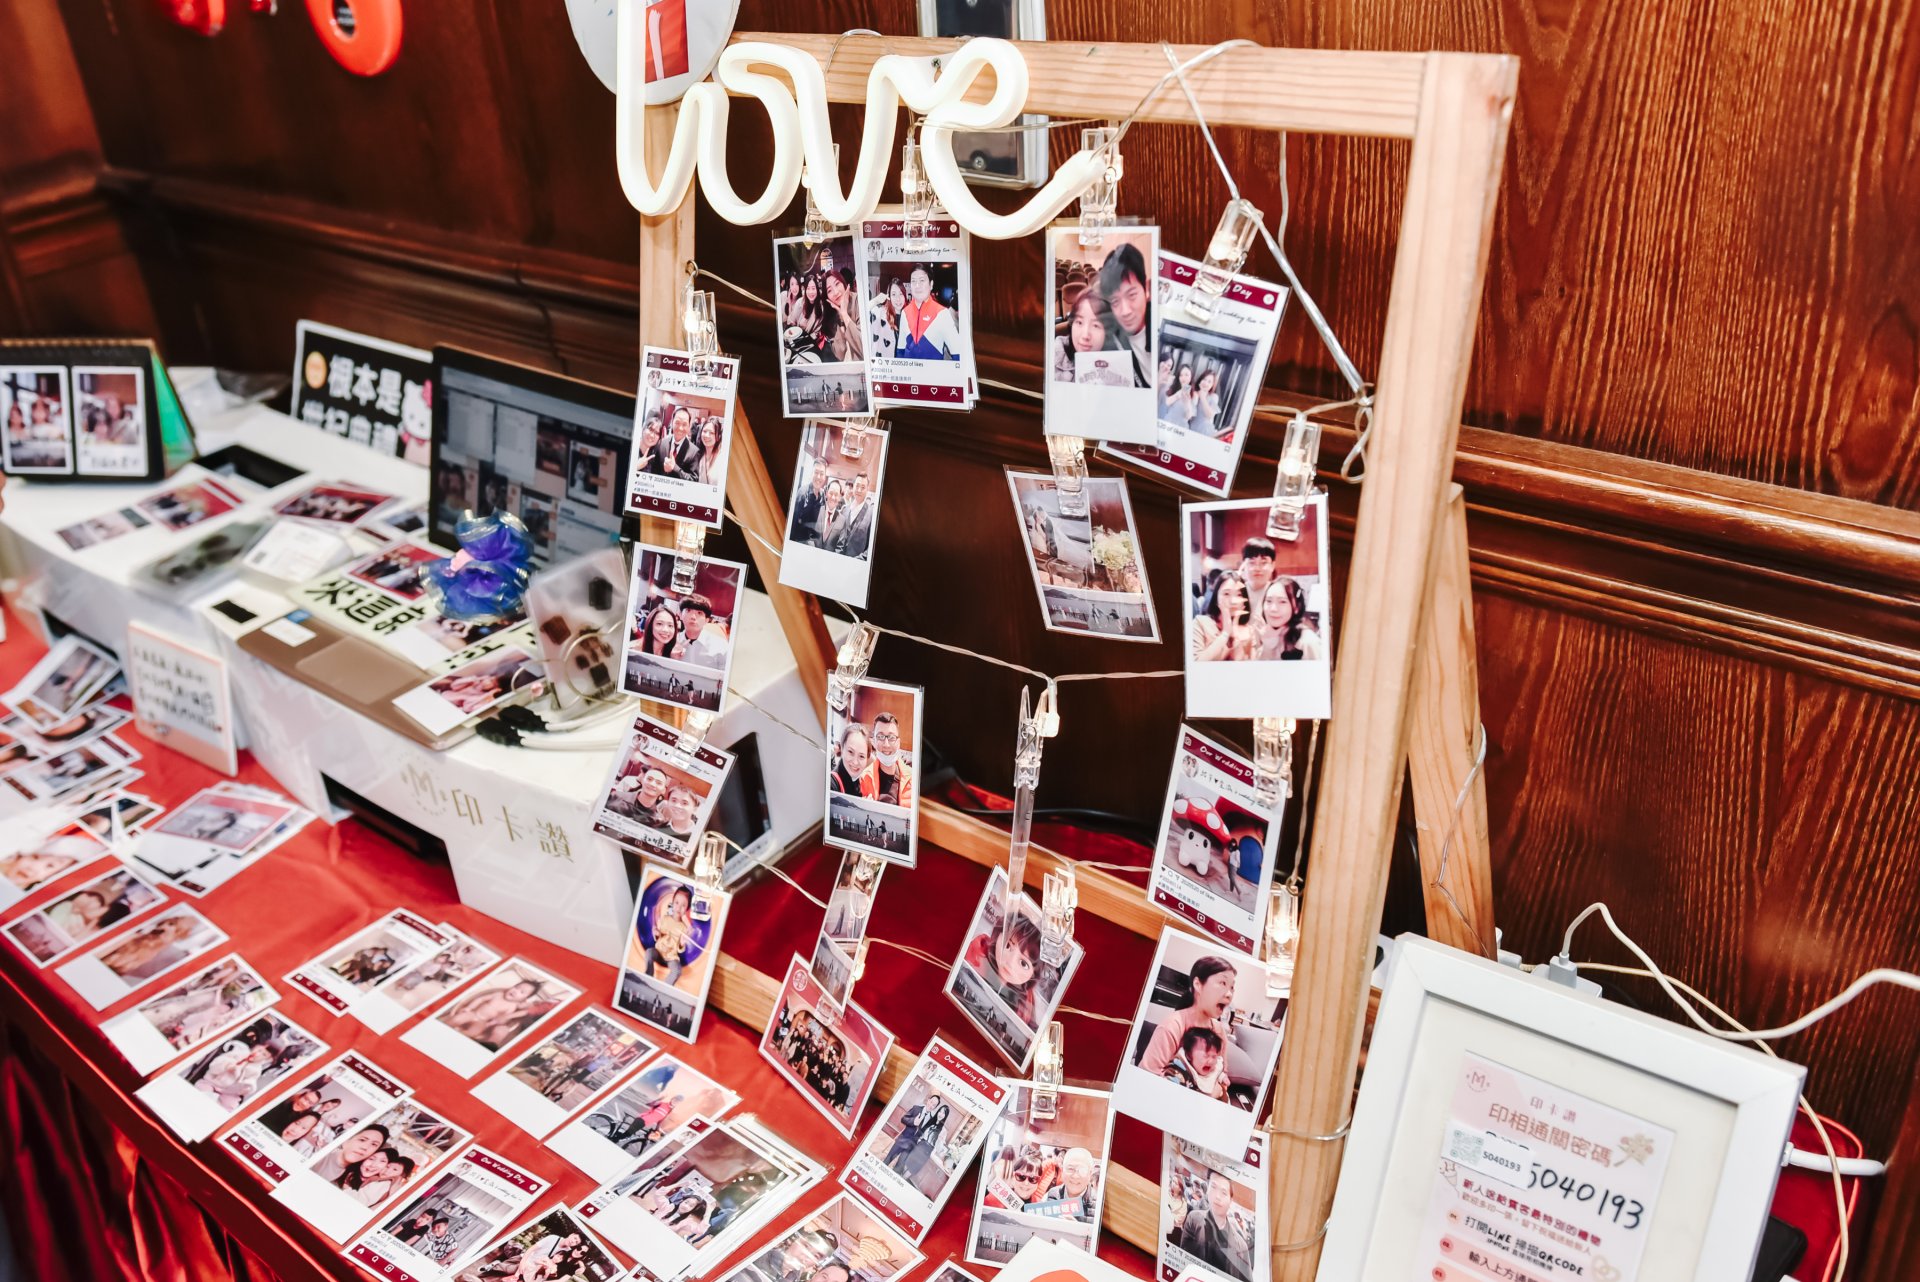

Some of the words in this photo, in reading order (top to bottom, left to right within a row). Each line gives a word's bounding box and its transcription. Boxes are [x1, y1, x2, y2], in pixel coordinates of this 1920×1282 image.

[616, 0, 1102, 239] love
[1174, 265, 1193, 278] Our
[1231, 284, 1252, 299] Day
[328, 354, 402, 416] 根本是
[1199, 745, 1213, 757] Our
[1214, 753, 1244, 776] Wedding
[943, 1054, 955, 1064] Our
[955, 1061, 977, 1082] Wedding
[977, 1077, 989, 1091] Day
[1482, 1150, 1521, 1172] 5040193
[1488, 1103, 1613, 1168] 印相通關密碼
[1527, 1162, 1644, 1229] 5040193
[1465, 1215, 1512, 1244] 打開LINE
[1515, 1237, 1584, 1276] 掃描QRCODE
